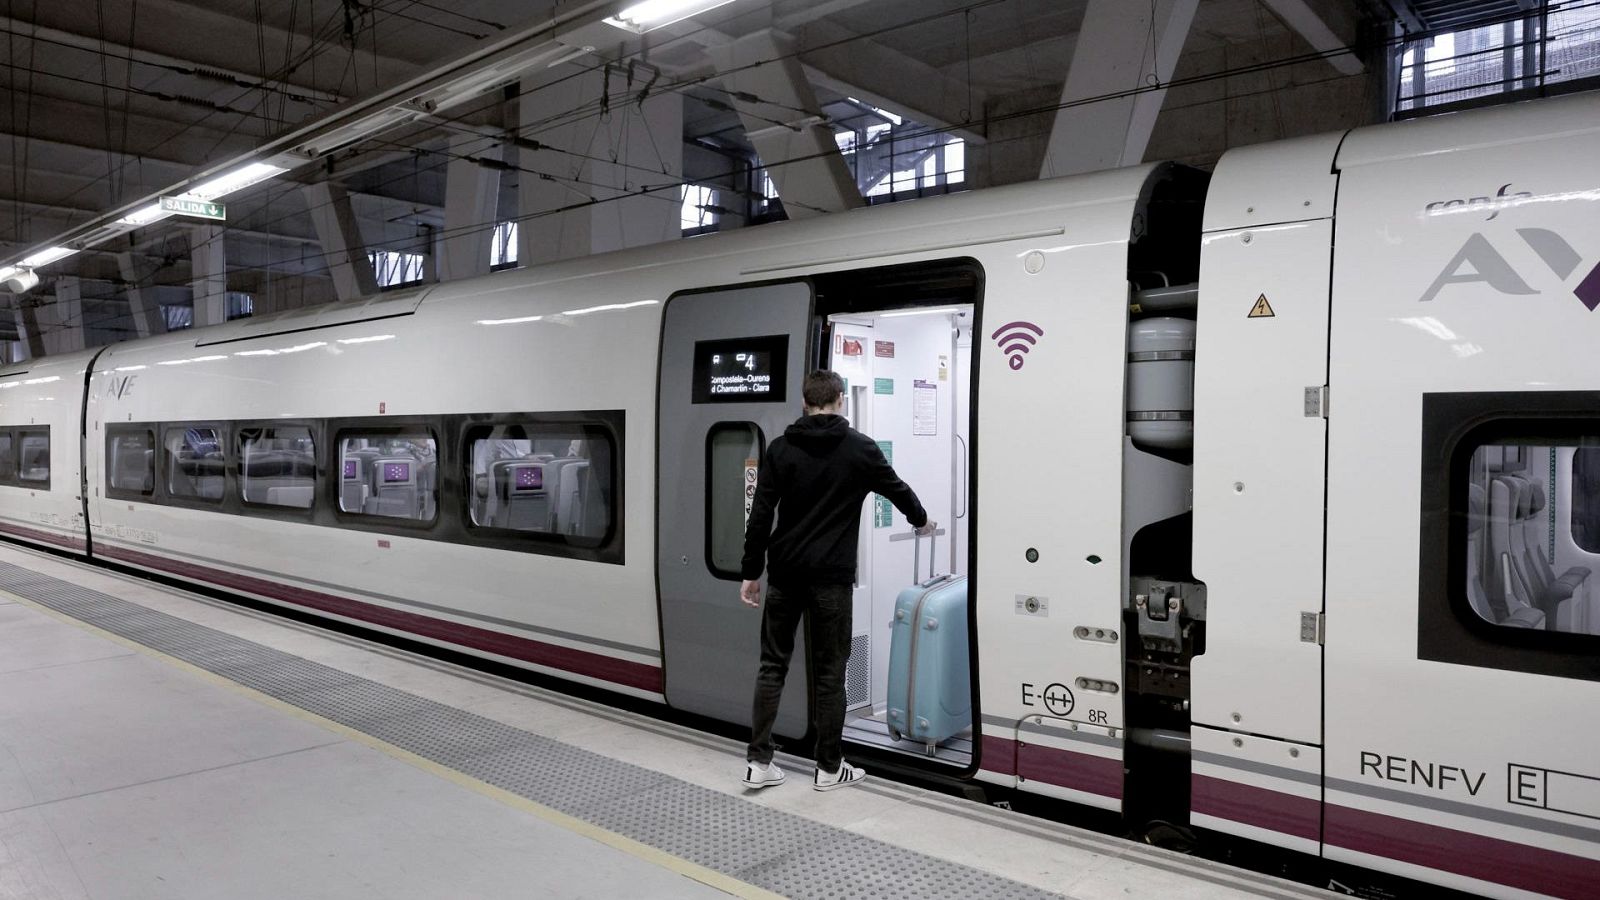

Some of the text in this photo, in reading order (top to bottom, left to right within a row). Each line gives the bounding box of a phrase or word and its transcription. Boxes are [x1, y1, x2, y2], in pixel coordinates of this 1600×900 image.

[166, 199, 207, 214] SALIDA
[745, 354, 754, 371] 4
[107, 375, 139, 400] AVE
[1088, 709, 1108, 724] 8R
[1360, 751, 1537, 801] RENFV E
